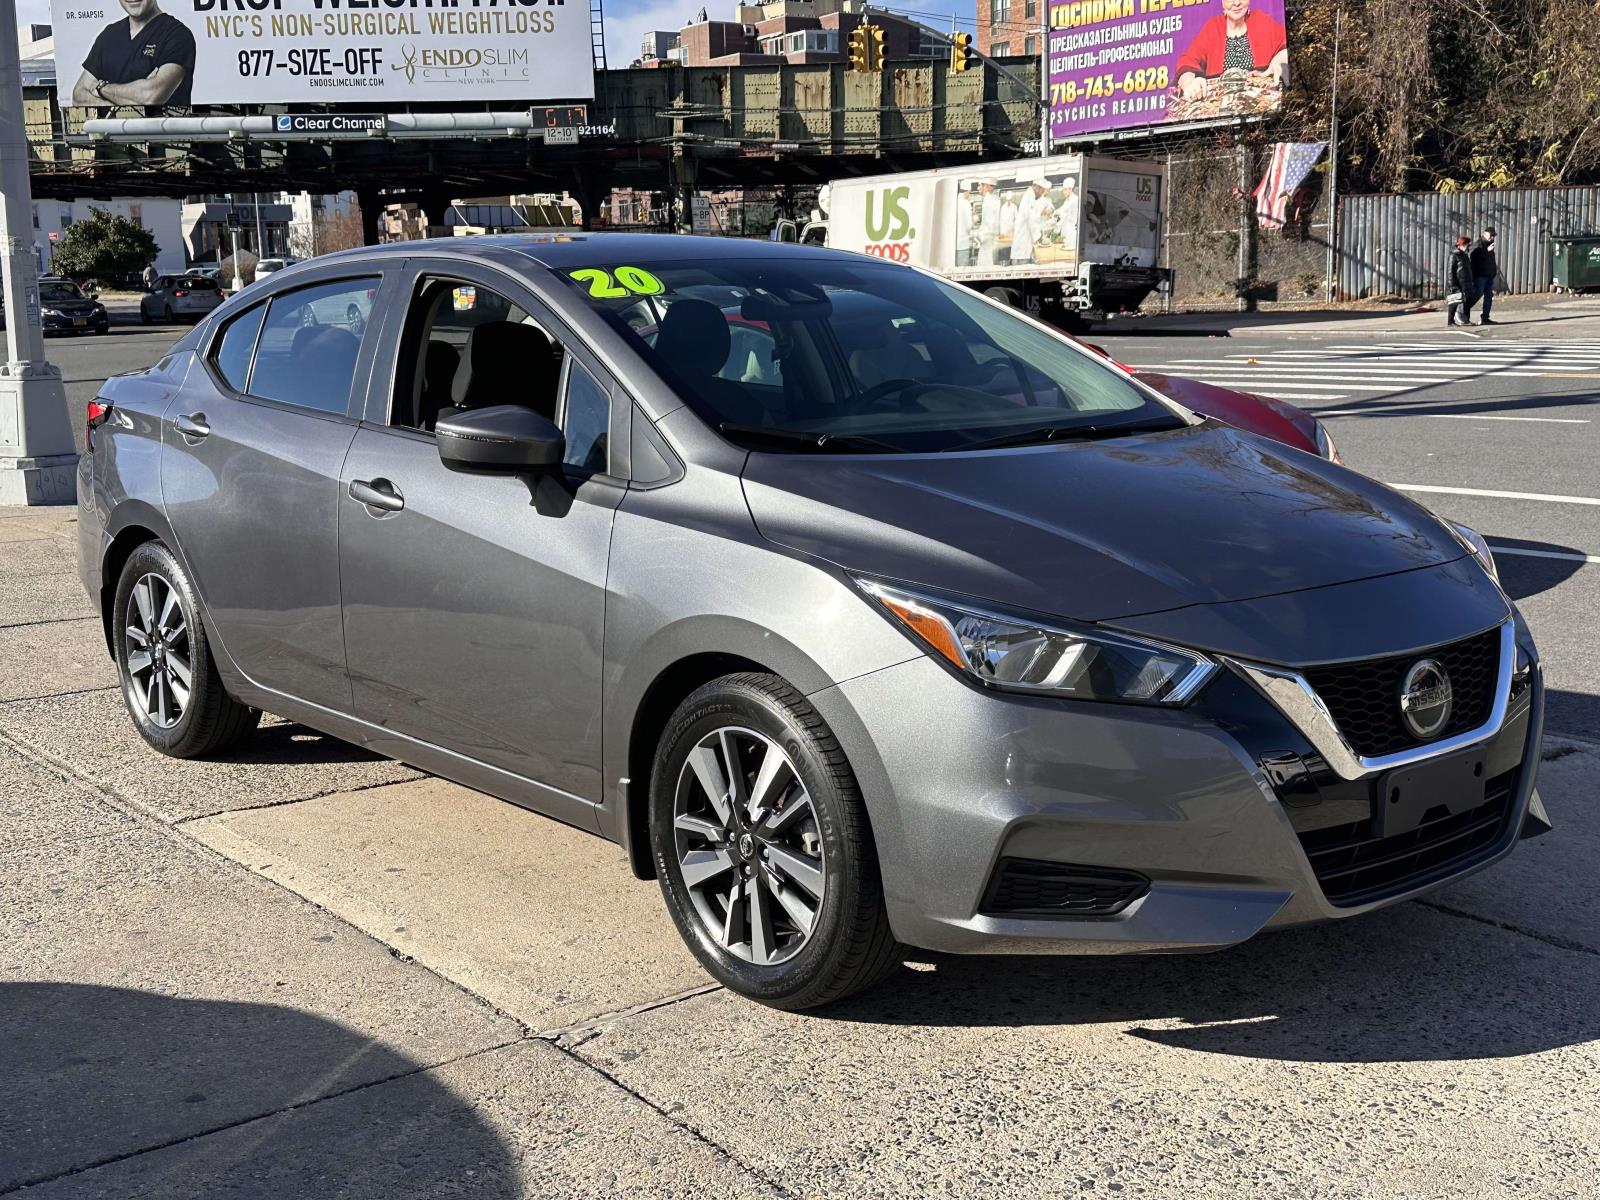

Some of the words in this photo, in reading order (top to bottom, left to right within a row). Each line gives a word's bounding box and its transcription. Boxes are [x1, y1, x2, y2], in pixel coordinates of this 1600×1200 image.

[206, 15, 263, 38] NYC'S
[271, 13, 421, 37] NON-SURGICAL
[428, 10, 555, 35] WEIGHTLOSS
[1050, 22, 1148, 54] ПРЕДСКАЗАТЕЛЬНИЦА
[1149, 15, 1182, 36] СУДЕБ
[238, 48, 383, 77] 877-SIZE-OFF
[422, 48, 528, 67] ENDOSLIM
[1050, 38, 1173, 74] ЦЕЛИТЕЛЬ-ПРОФЕССИОНАЛ
[309, 78, 384, 87] ENDOSLIMCLINIC.COM
[1050, 65, 1169, 106] 718-743-6828
[294, 117, 330, 129] Clear
[332, 116, 385, 129] Channel
[1050, 103, 1106, 125] PSYCHICS
[1112, 94, 1166, 115] READING
[578, 125, 615, 135] 921164
[569, 266, 665, 298] 20
